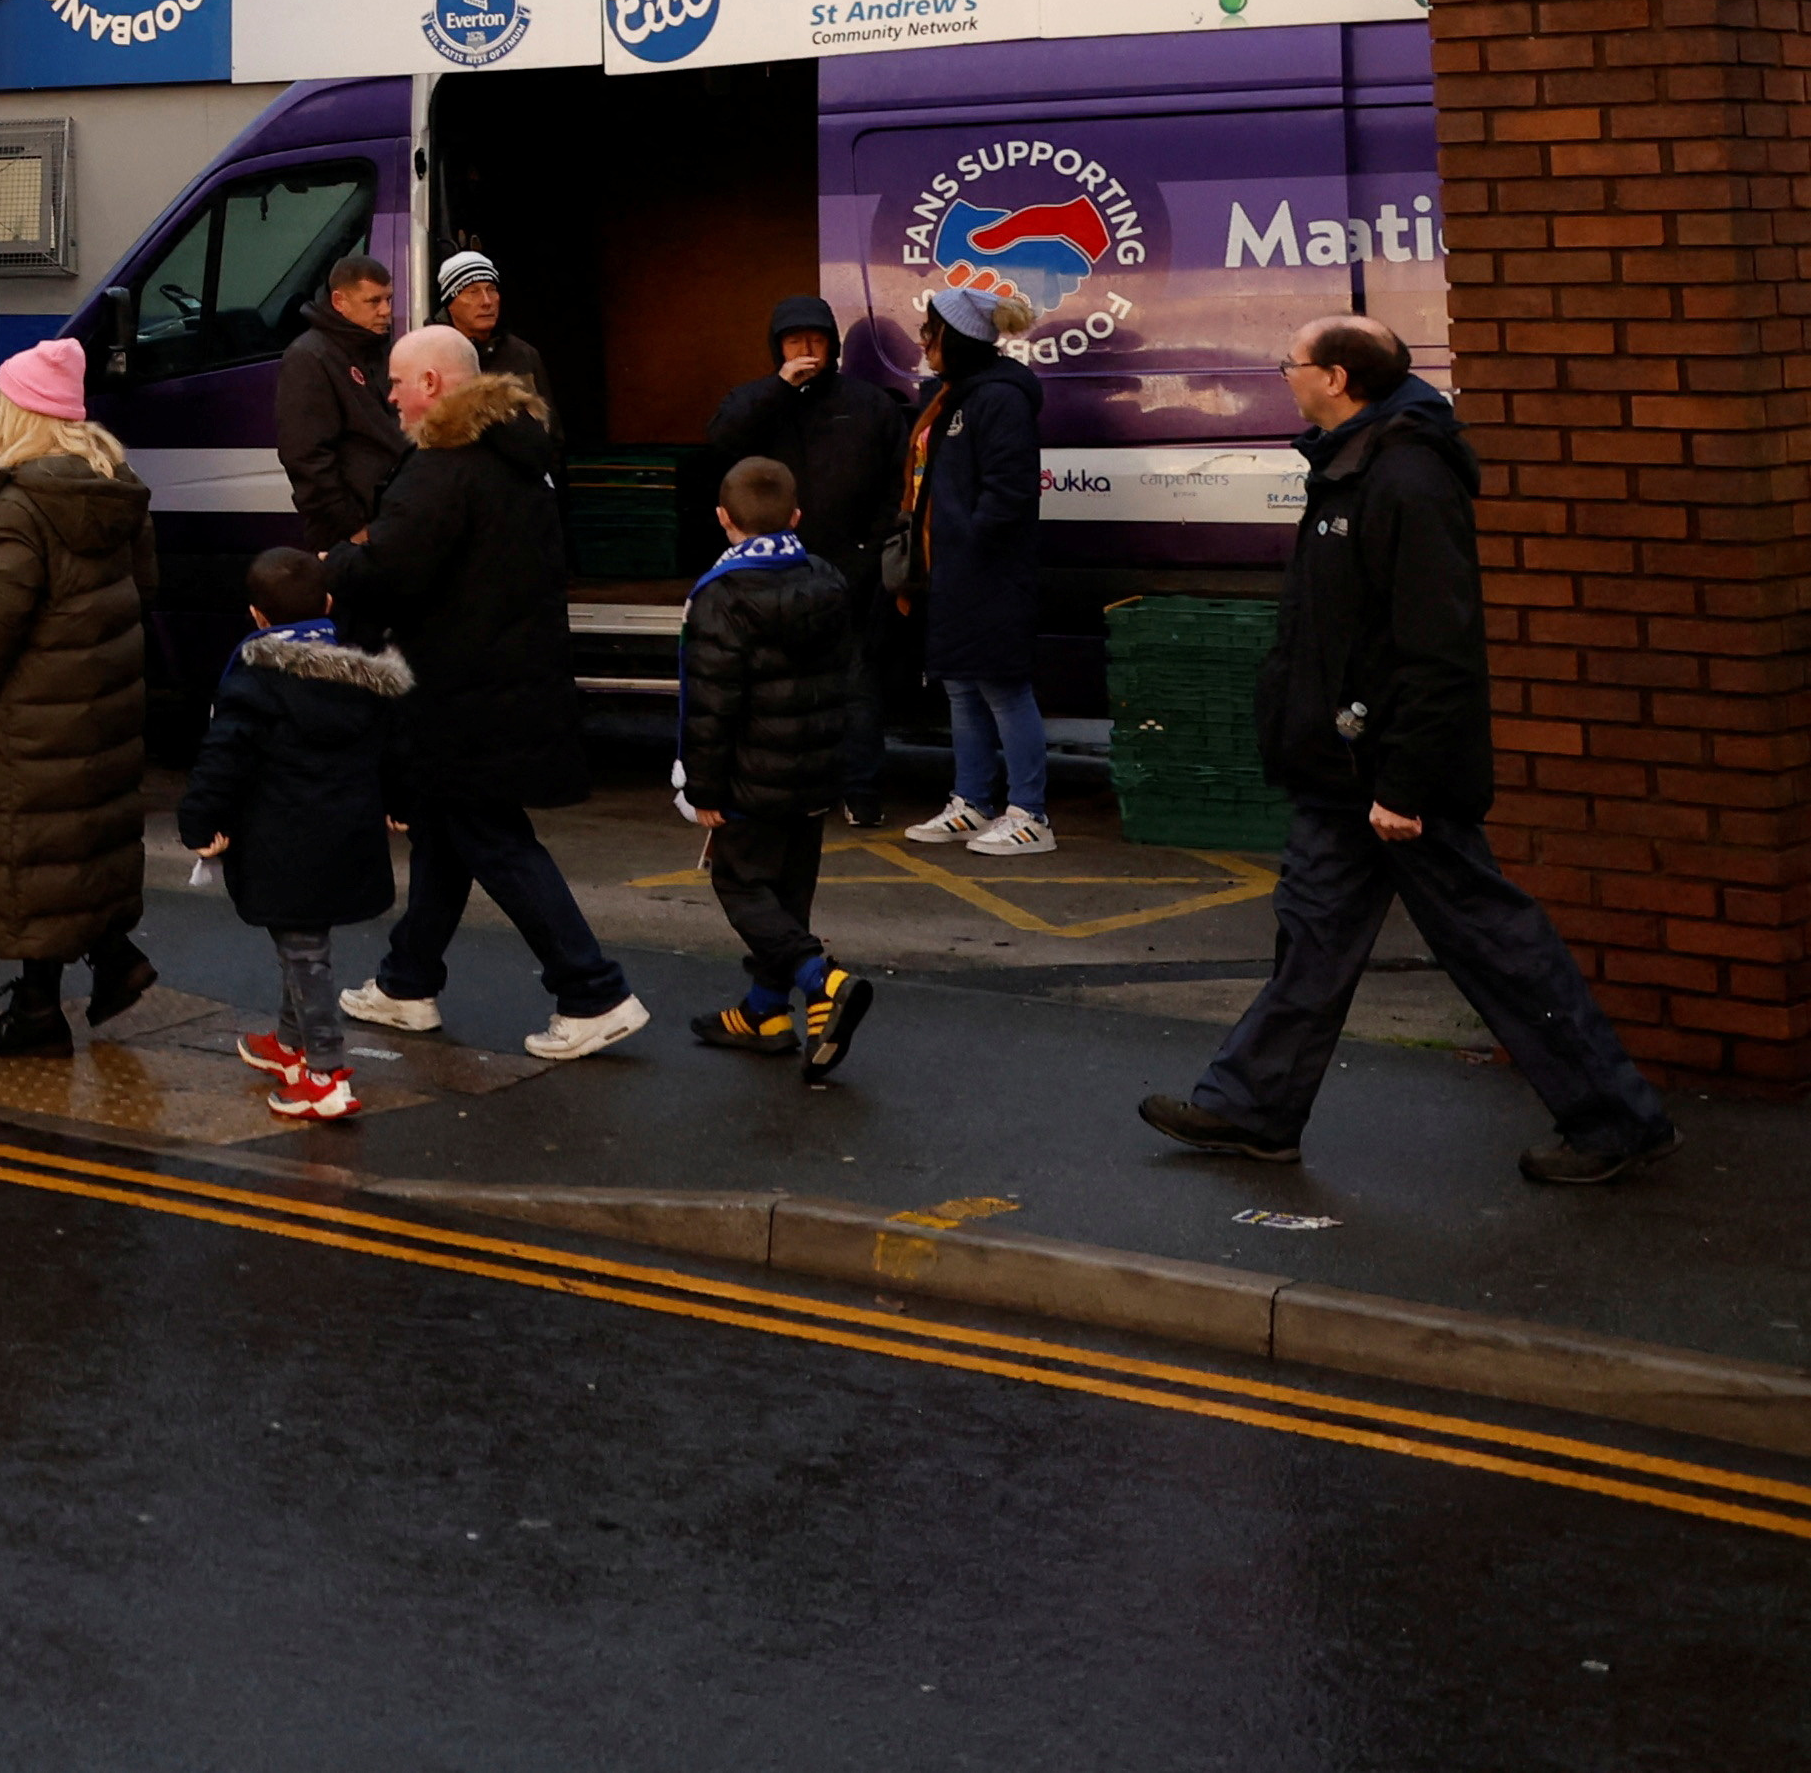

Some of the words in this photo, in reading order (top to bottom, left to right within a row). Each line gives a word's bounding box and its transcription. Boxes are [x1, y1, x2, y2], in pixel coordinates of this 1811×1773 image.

[446, 12, 506, 29] Everton
[810, 3, 839, 27] St
[438, 43, 465, 63] SATIS
[489, 22, 527, 60] OPTIMUM
[811, 26, 904, 46] Community
[906, 17, 979, 40] Network
[903, 173, 961, 266] FANS
[957, 140, 1147, 267] SUPPORTING
